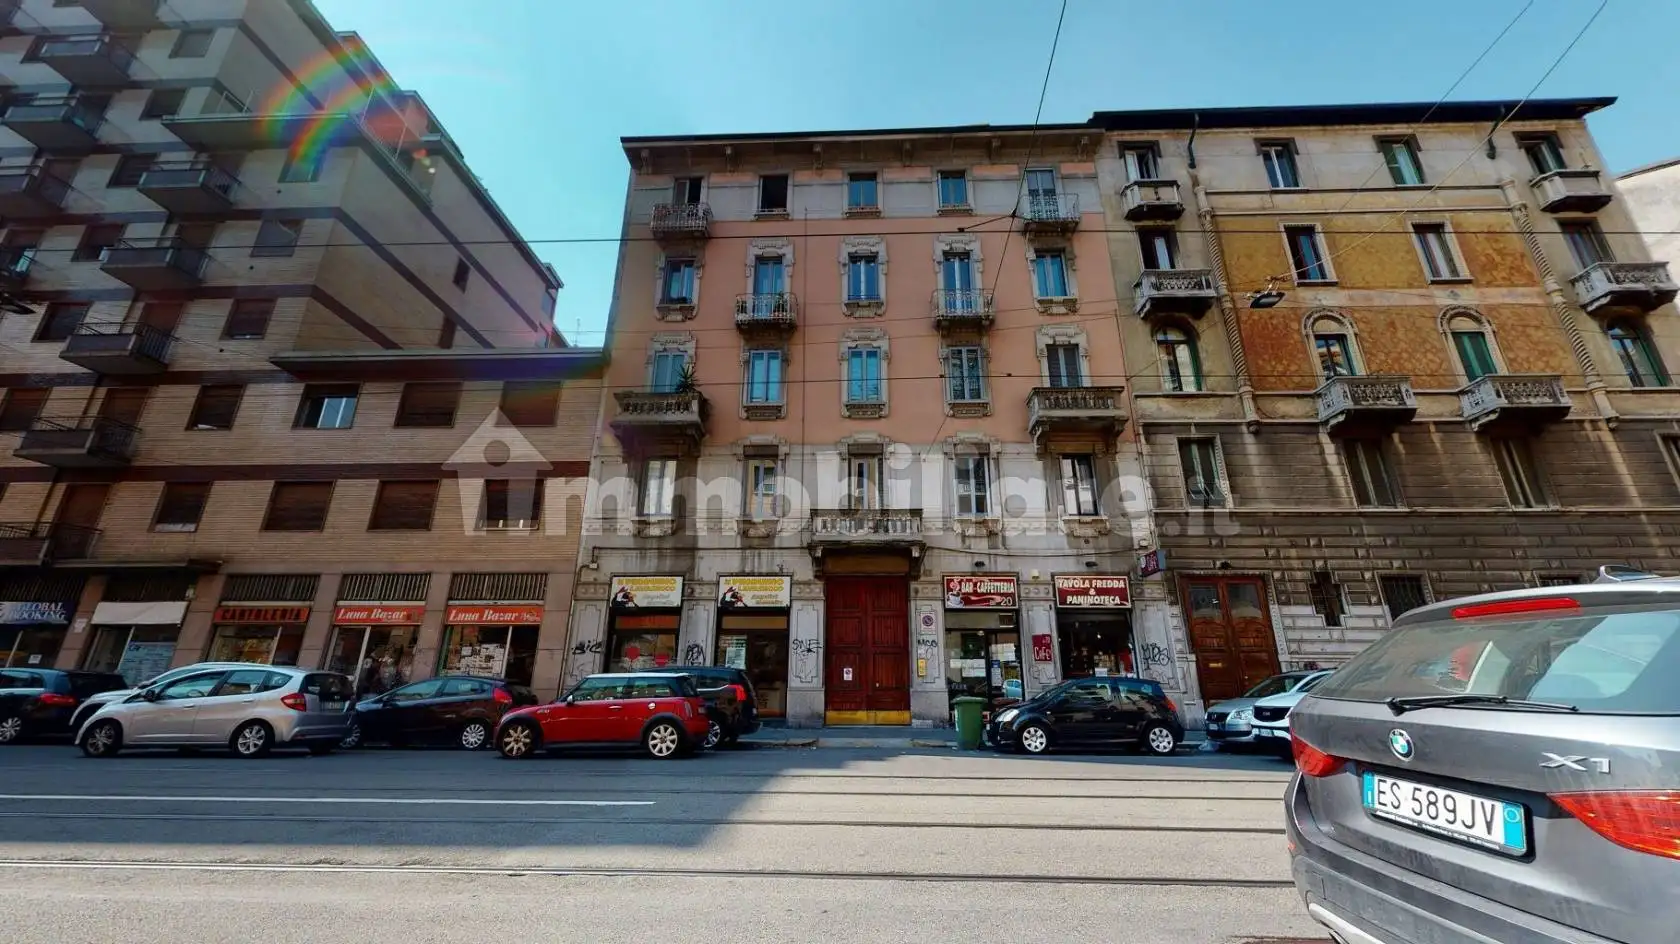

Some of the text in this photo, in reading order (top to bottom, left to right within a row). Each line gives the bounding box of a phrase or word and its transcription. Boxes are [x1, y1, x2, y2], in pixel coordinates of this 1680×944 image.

[1059, 579, 1125, 588] TAVOLA FREDDA
[1001, 597, 1013, 606] 20
[1066, 595, 1120, 604] PANINOTECA
[337, 608, 407, 619] Luna Bazar
[449, 609, 480, 621] Luna
[482, 609, 519, 621] Bazar
[1539, 751, 1611, 775] X1
[1377, 778, 1402, 811] ES
